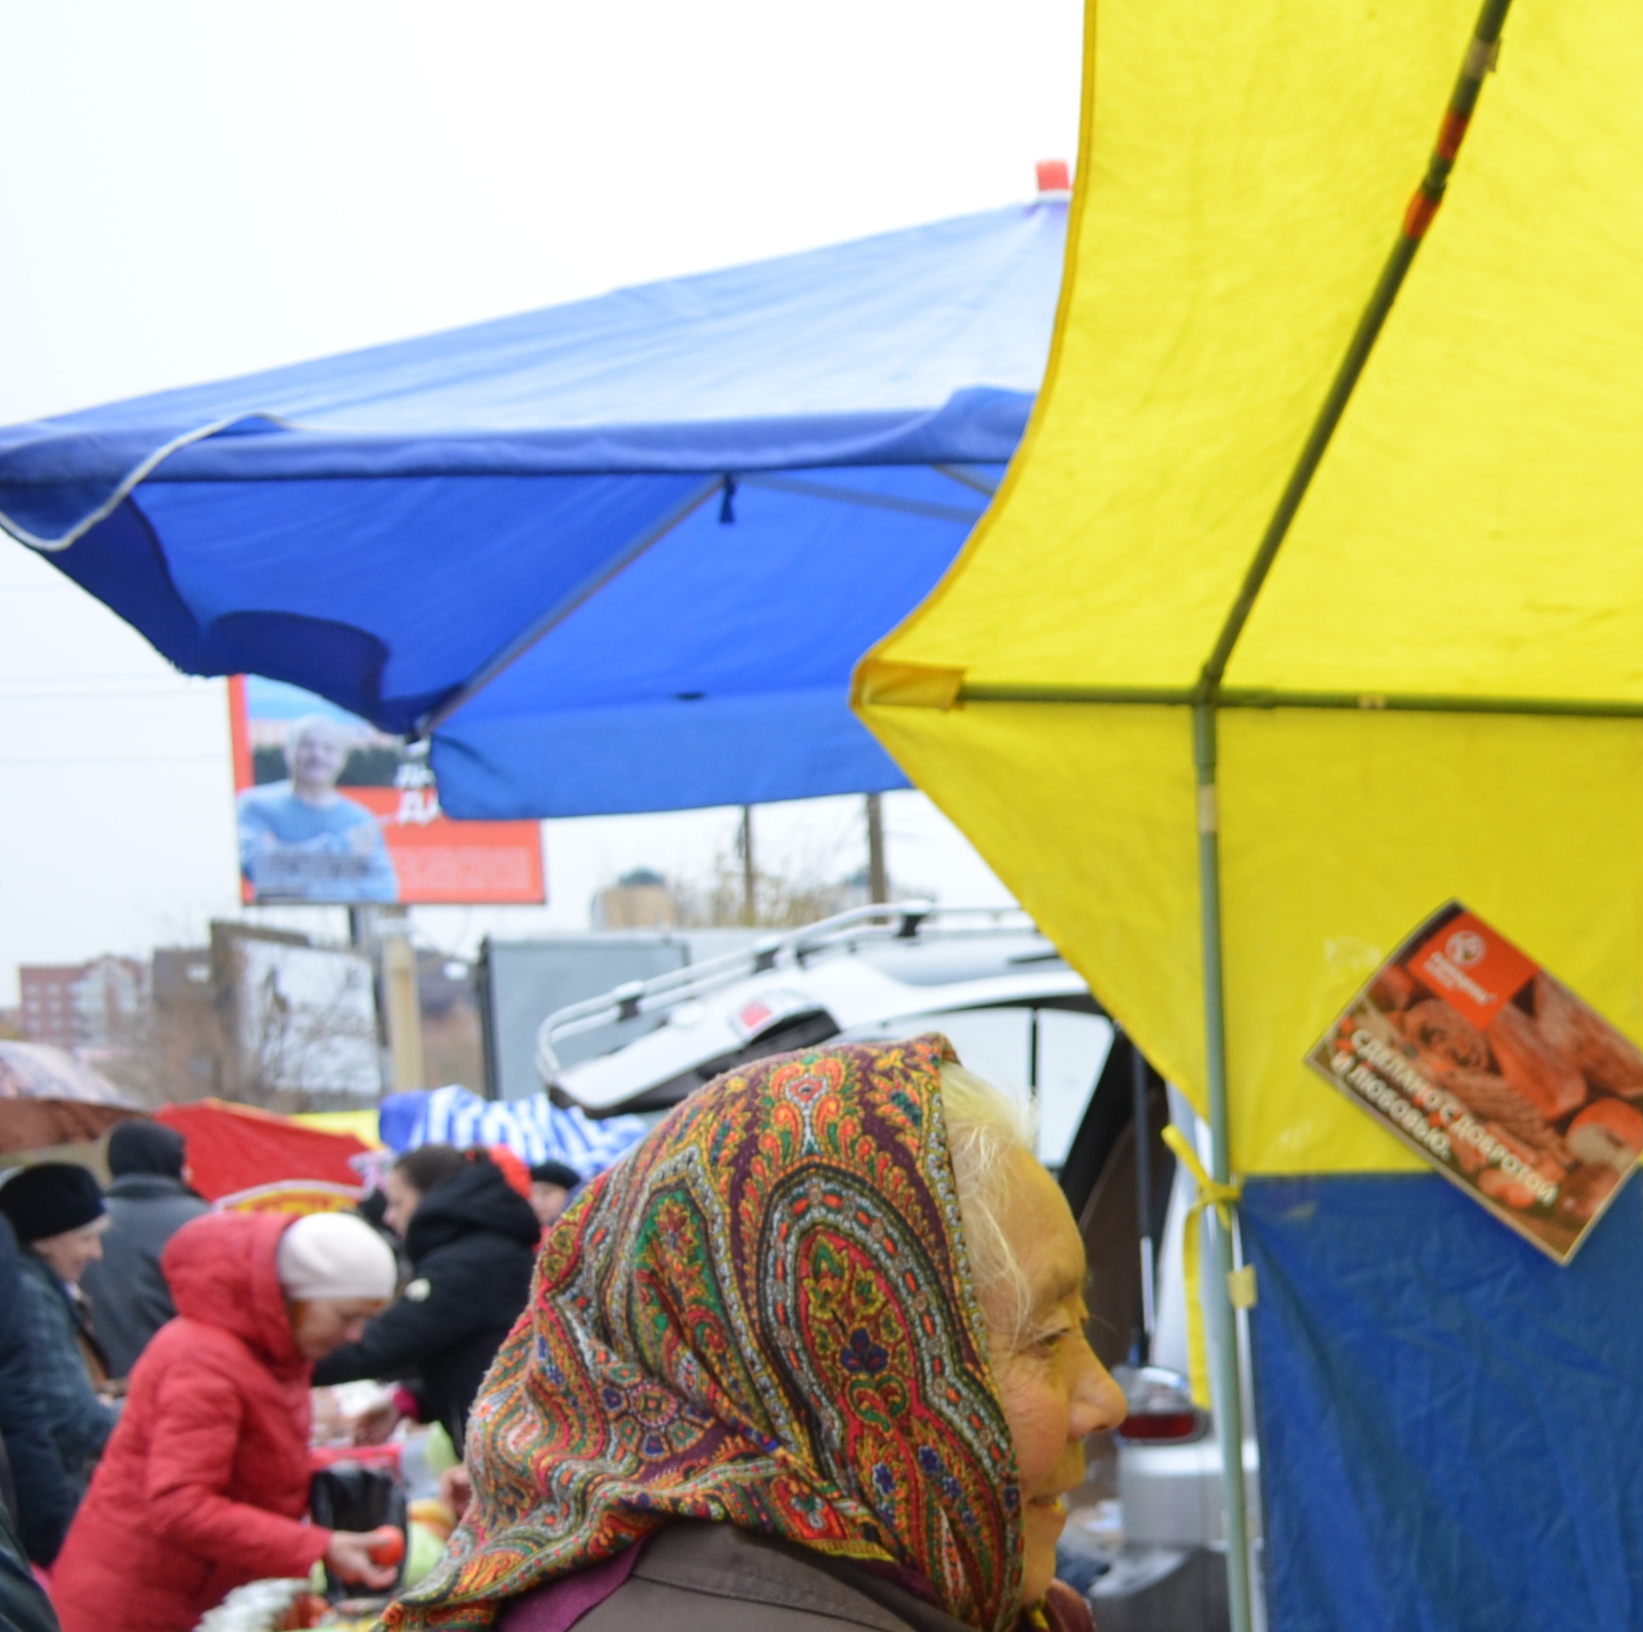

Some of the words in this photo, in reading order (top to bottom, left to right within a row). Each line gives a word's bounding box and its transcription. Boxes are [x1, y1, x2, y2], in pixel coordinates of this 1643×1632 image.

[1331, 1051, 1354, 1079] И
[1352, 1030, 1441, 1111] СДЕЛАНО
[1440, 1103, 1462, 1124] С
[1450, 1113, 1557, 1206] ДОБРОТОЙ
